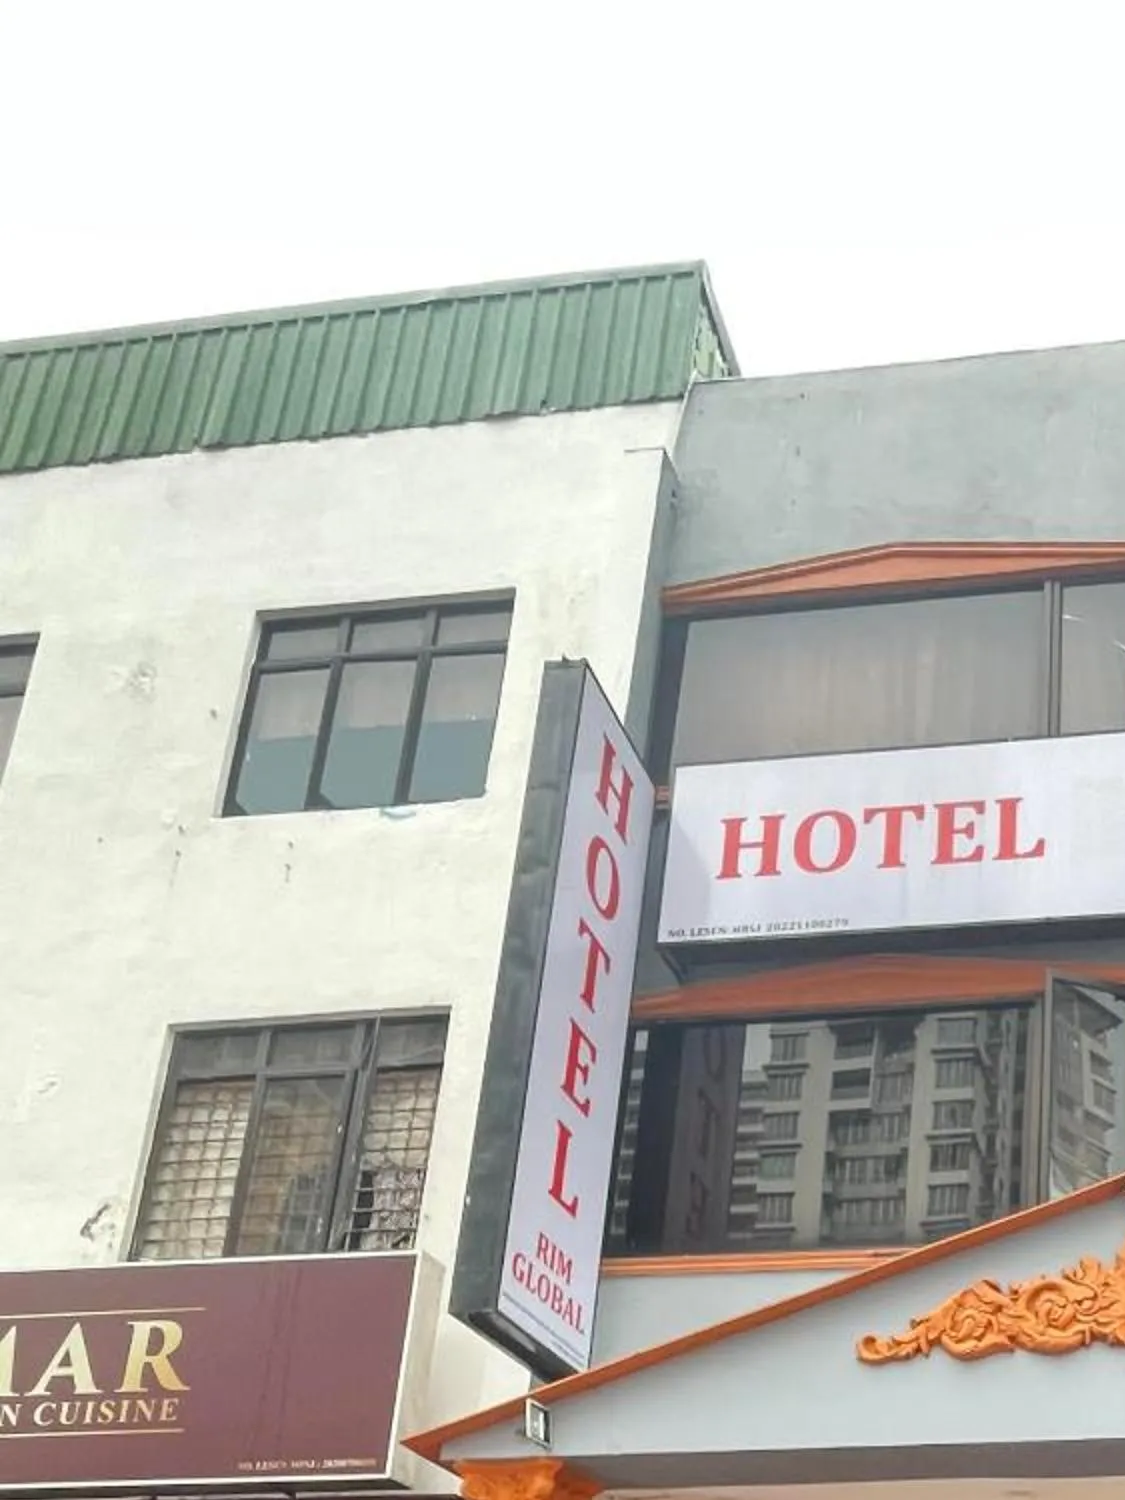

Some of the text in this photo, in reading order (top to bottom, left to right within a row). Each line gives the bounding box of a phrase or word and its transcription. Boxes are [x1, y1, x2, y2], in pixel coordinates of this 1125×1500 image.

[715, 797, 1046, 880] HOTEL
[547, 732, 635, 1220] HOTEL
[511, 1252, 585, 1336] GLOBAL
[536, 1231, 573, 1286] RIM
[32, 1398, 179, 1426] CUISINE
